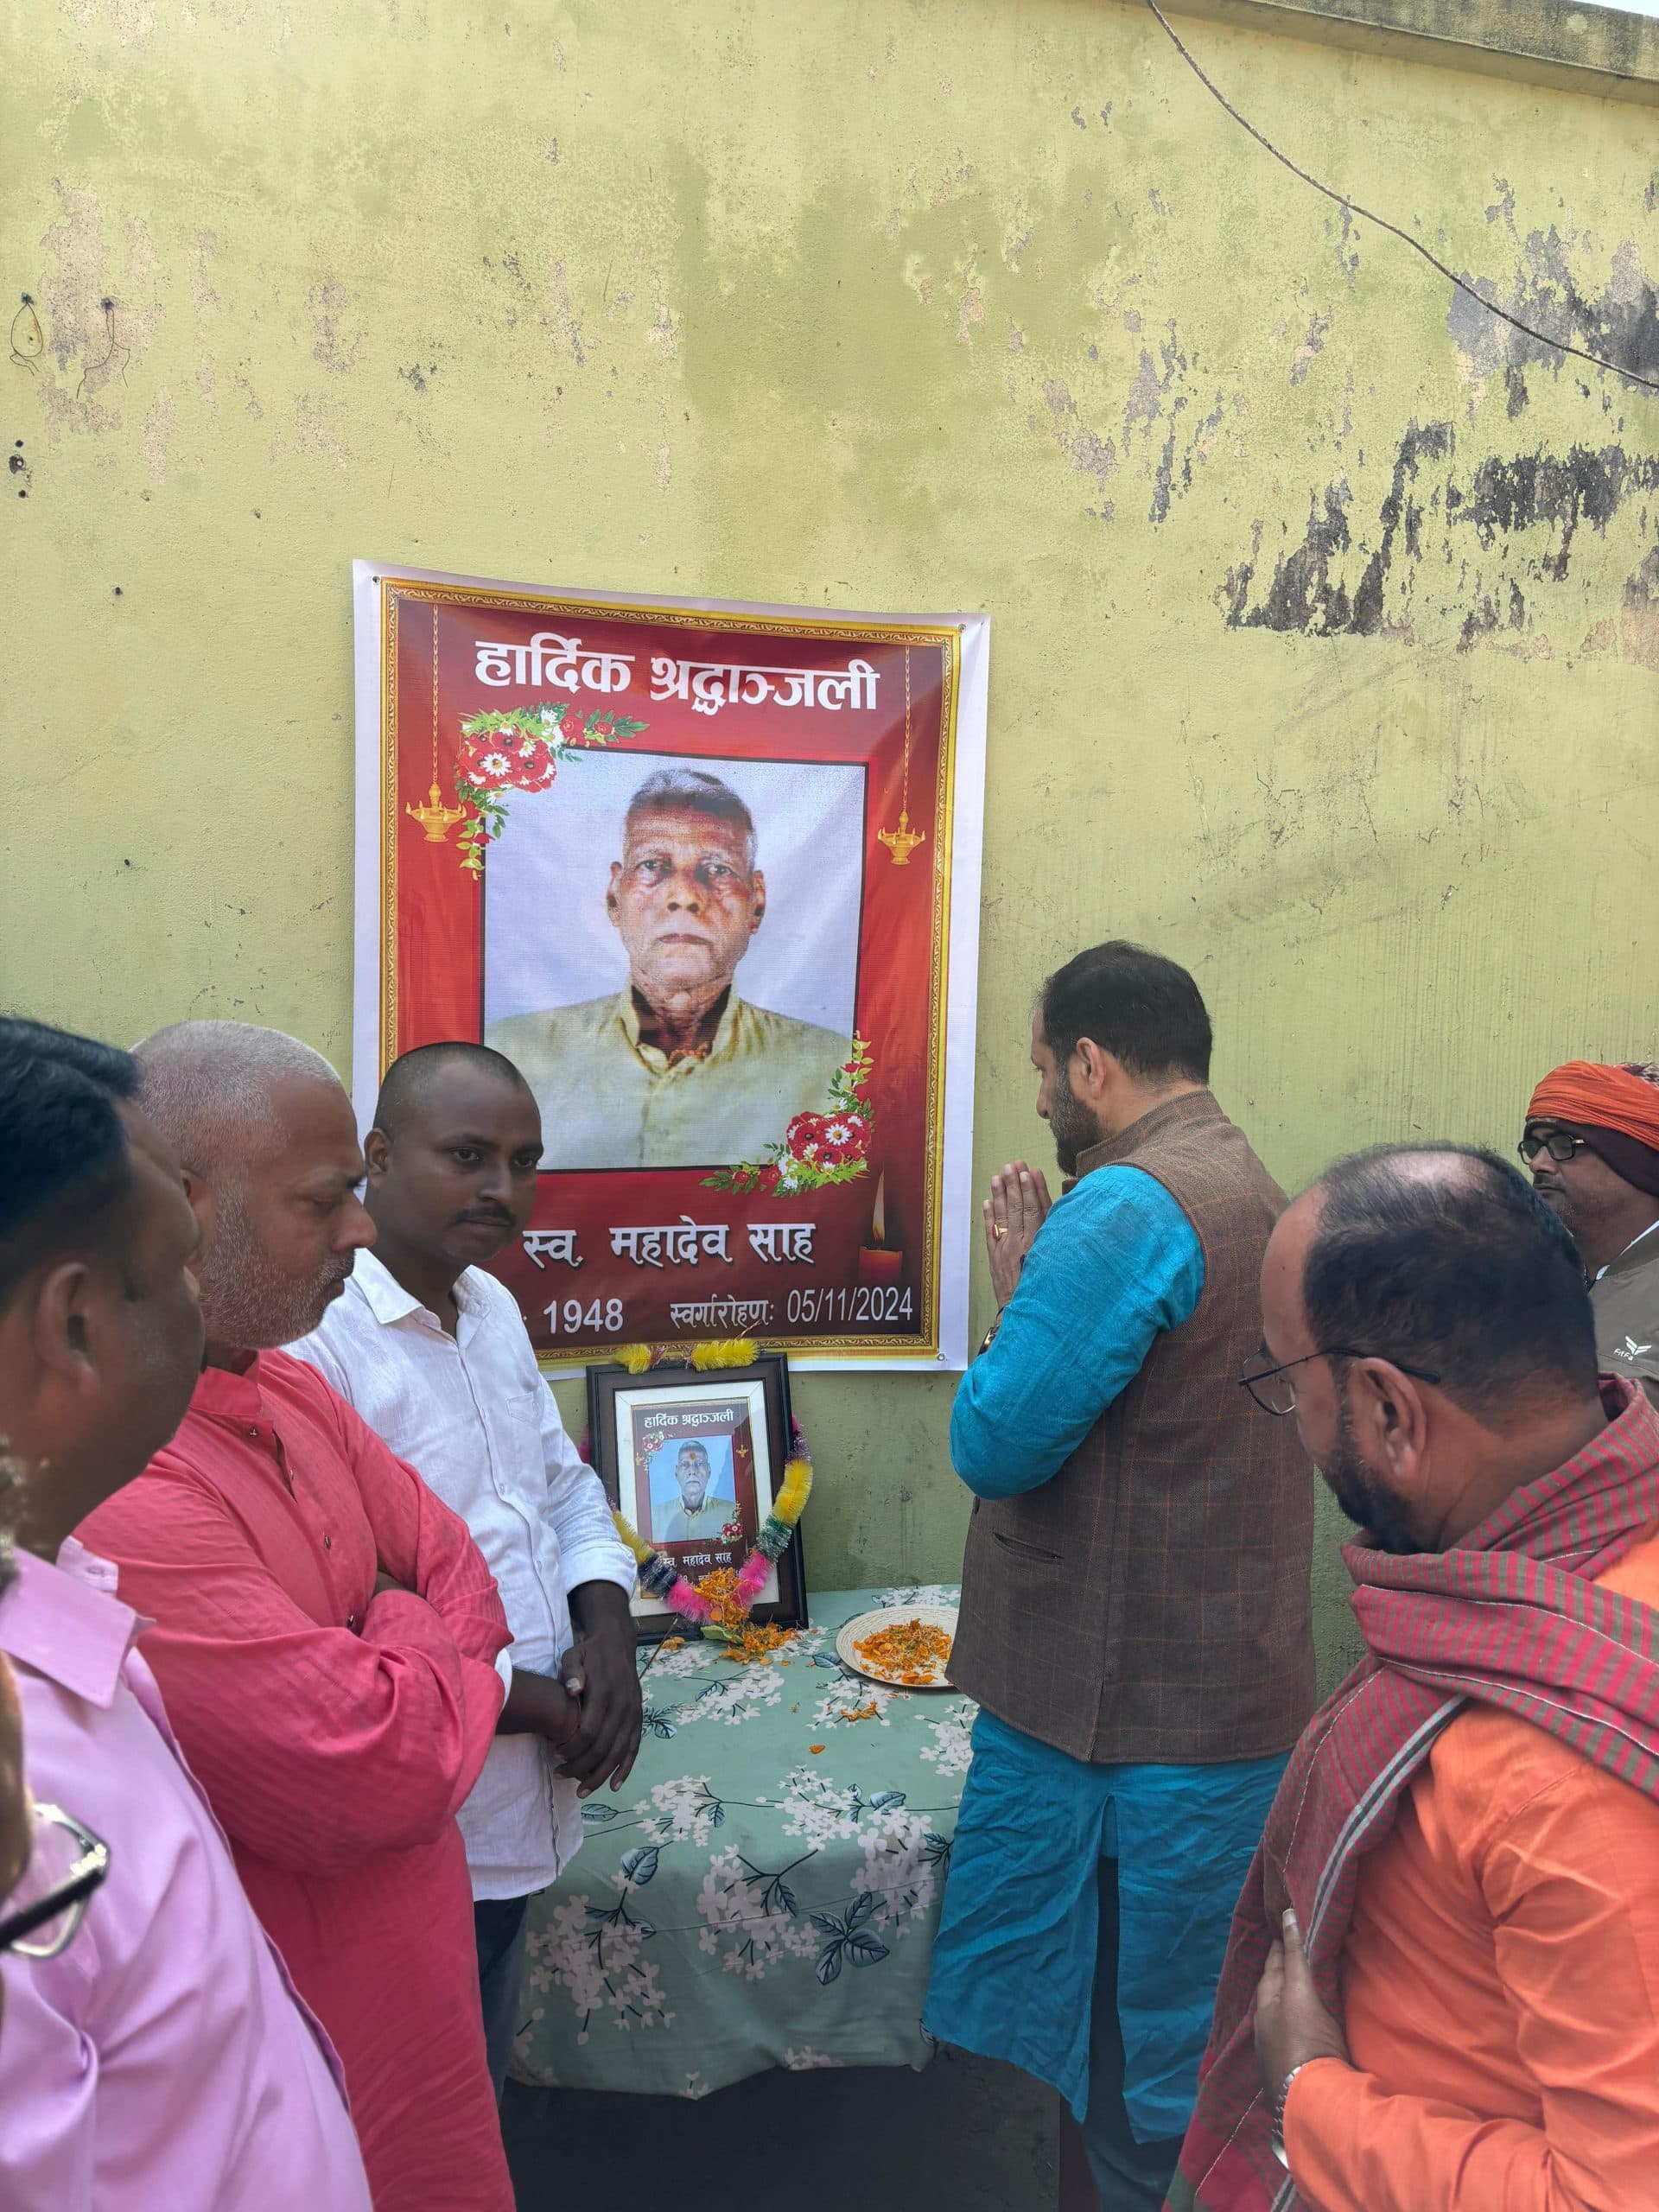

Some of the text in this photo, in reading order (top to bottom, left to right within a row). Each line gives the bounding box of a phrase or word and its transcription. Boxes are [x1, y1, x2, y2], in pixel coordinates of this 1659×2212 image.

[474, 632, 636, 695] हार्दिक
[522, 1215, 817, 1269] स्व. महादेव साह
[543, 1298, 624, 1334] 1948
[787, 1287, 913, 1324] 05/11/2024
[644, 1413, 678, 1428] हार्दिक
[682, 1553, 713, 1567] महादेव
[715, 1552, 733, 1564] साह
